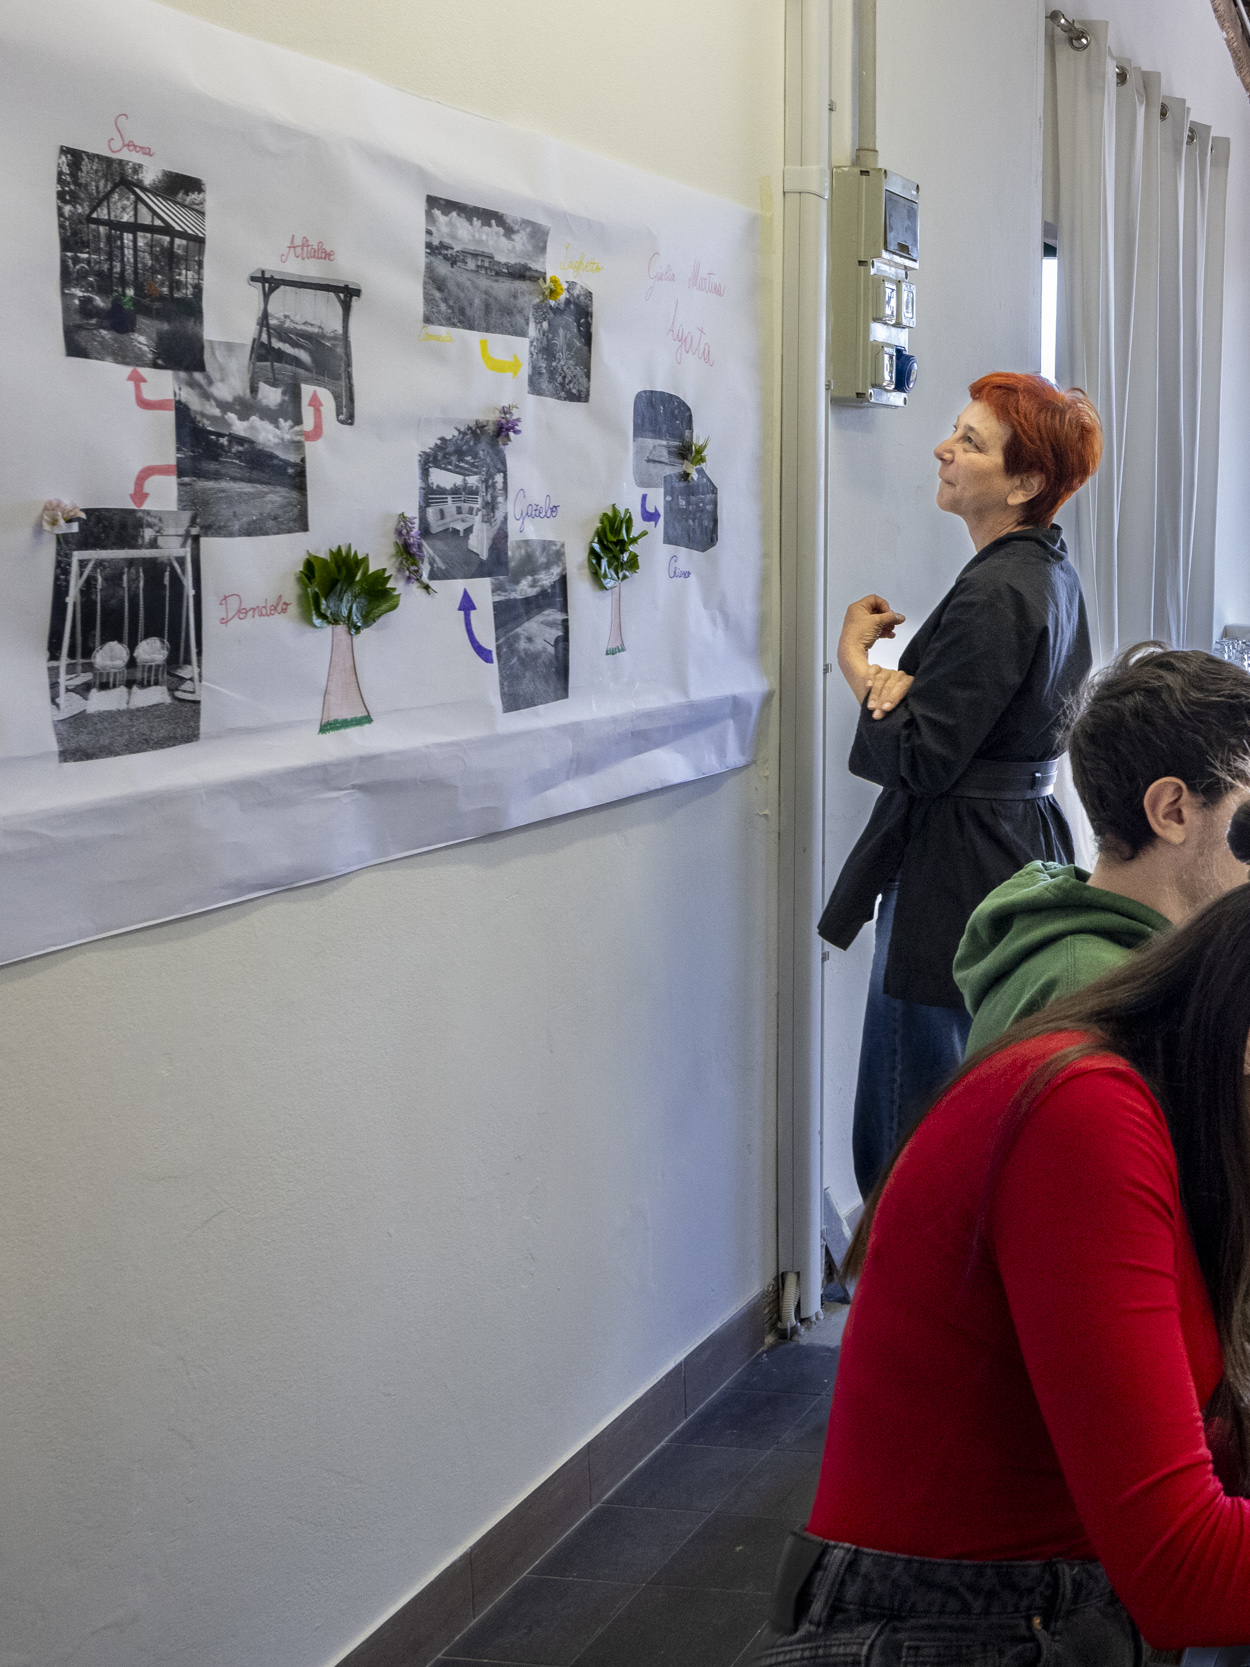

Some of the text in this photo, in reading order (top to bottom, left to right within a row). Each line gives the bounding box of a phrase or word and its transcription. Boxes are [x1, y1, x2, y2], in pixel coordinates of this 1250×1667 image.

[666, 299, 714, 366] Agata
[513, 488, 560, 533] Gazebo
[219, 593, 292, 627] Dondolo
